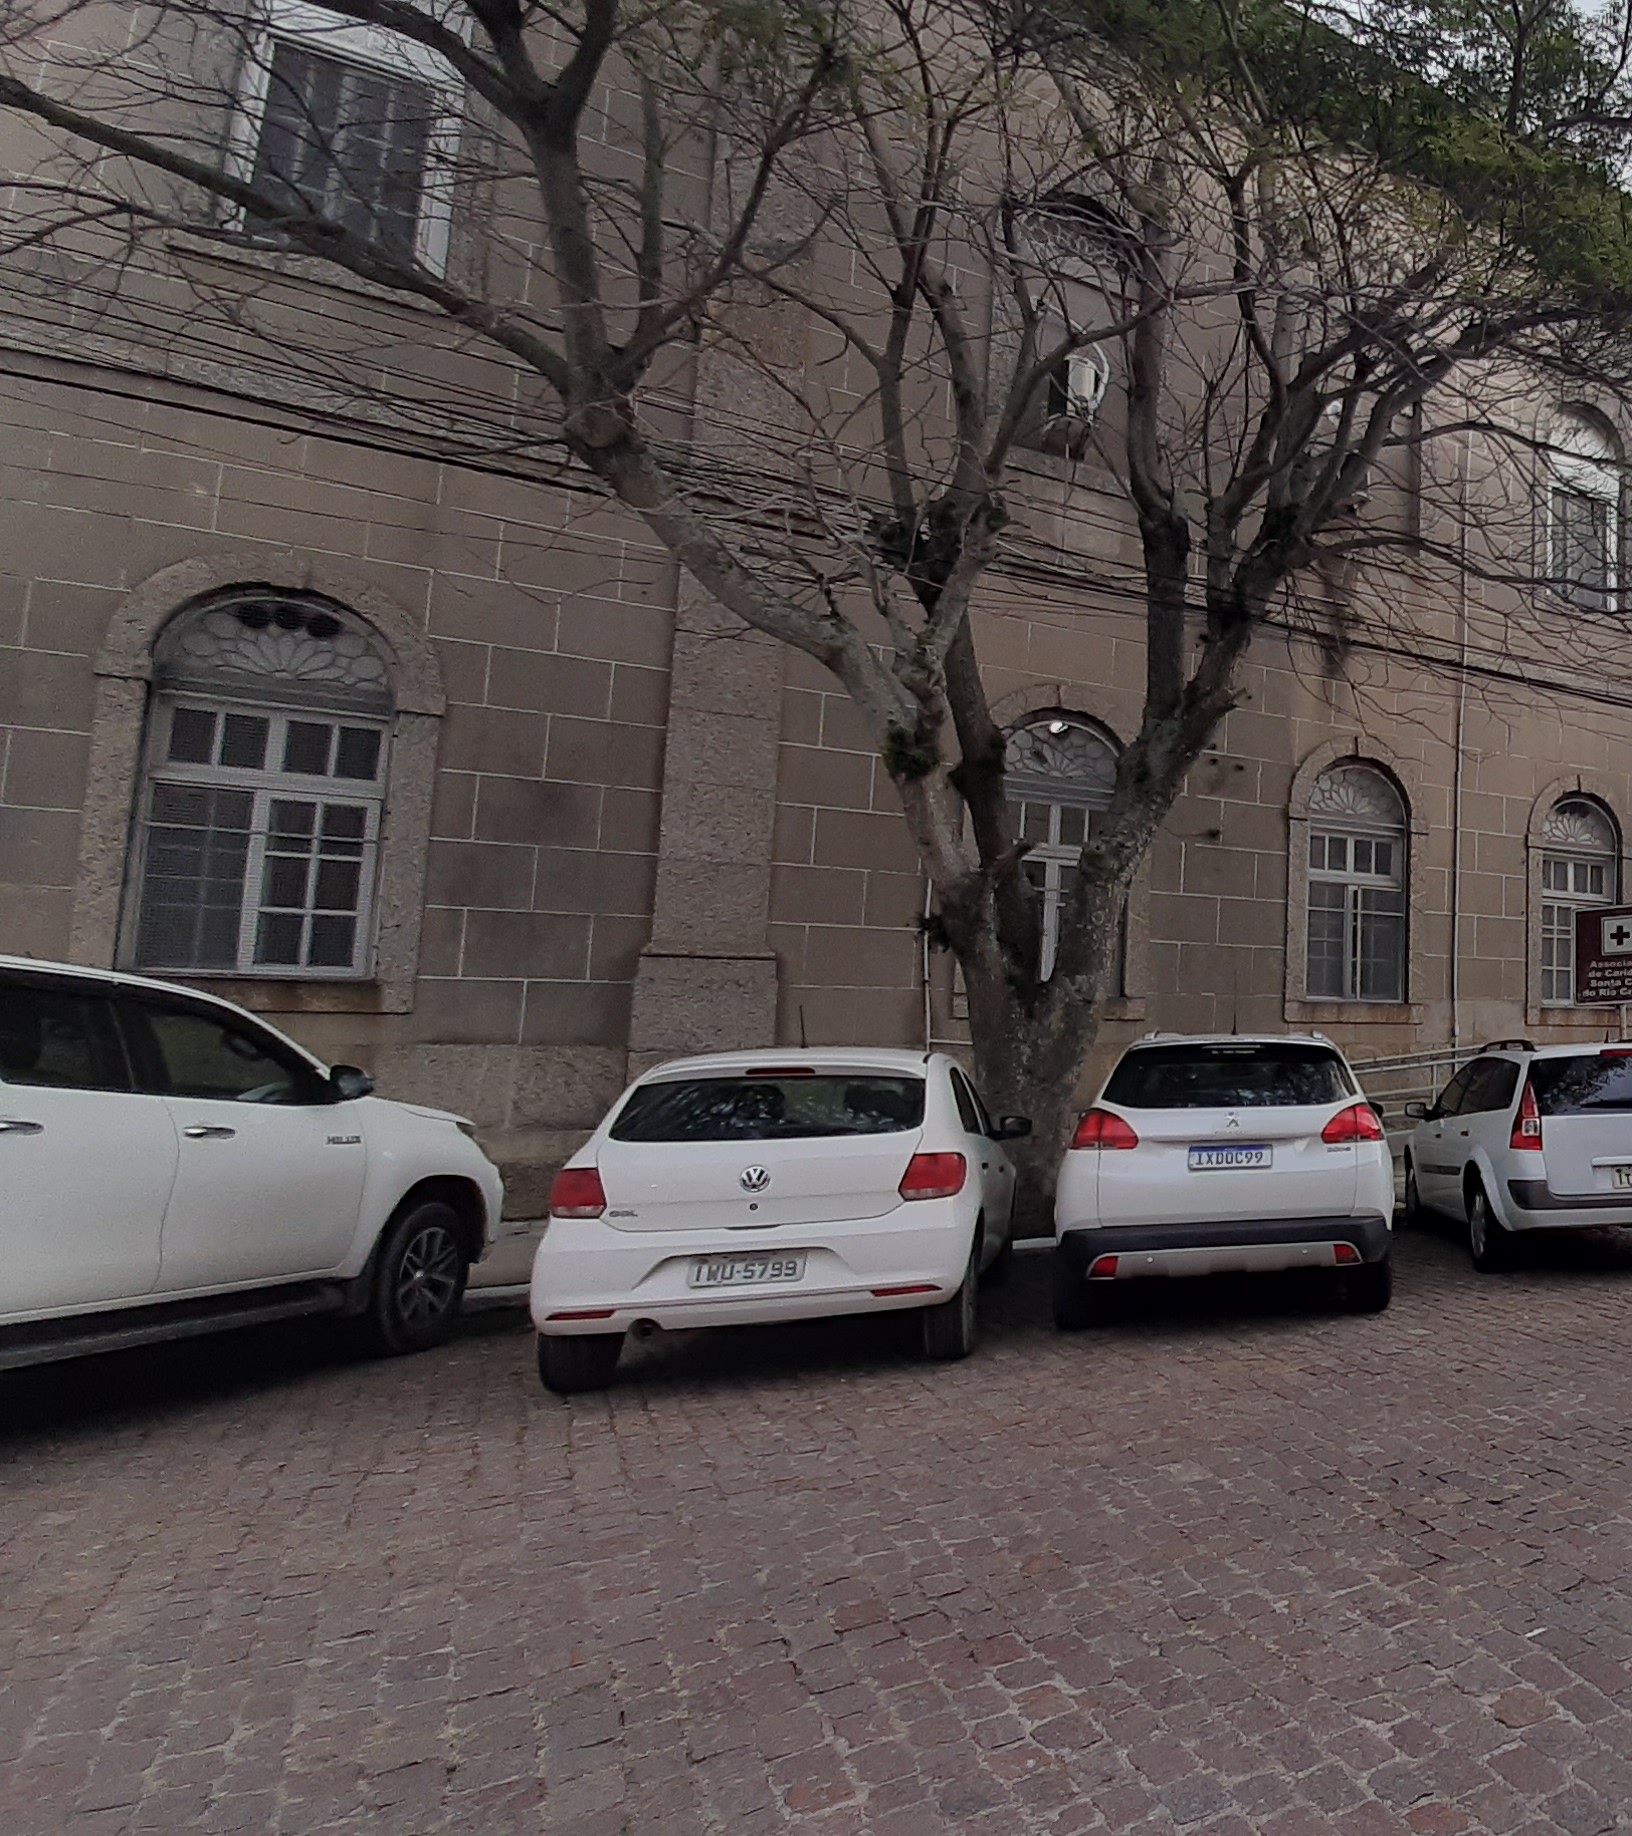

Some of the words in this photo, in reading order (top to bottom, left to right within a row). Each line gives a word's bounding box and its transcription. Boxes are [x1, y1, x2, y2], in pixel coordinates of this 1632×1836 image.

[1588, 969, 1602, 977] de
[1590, 979, 1622, 987] Santa
[1599, 988, 1617, 996] Rio
